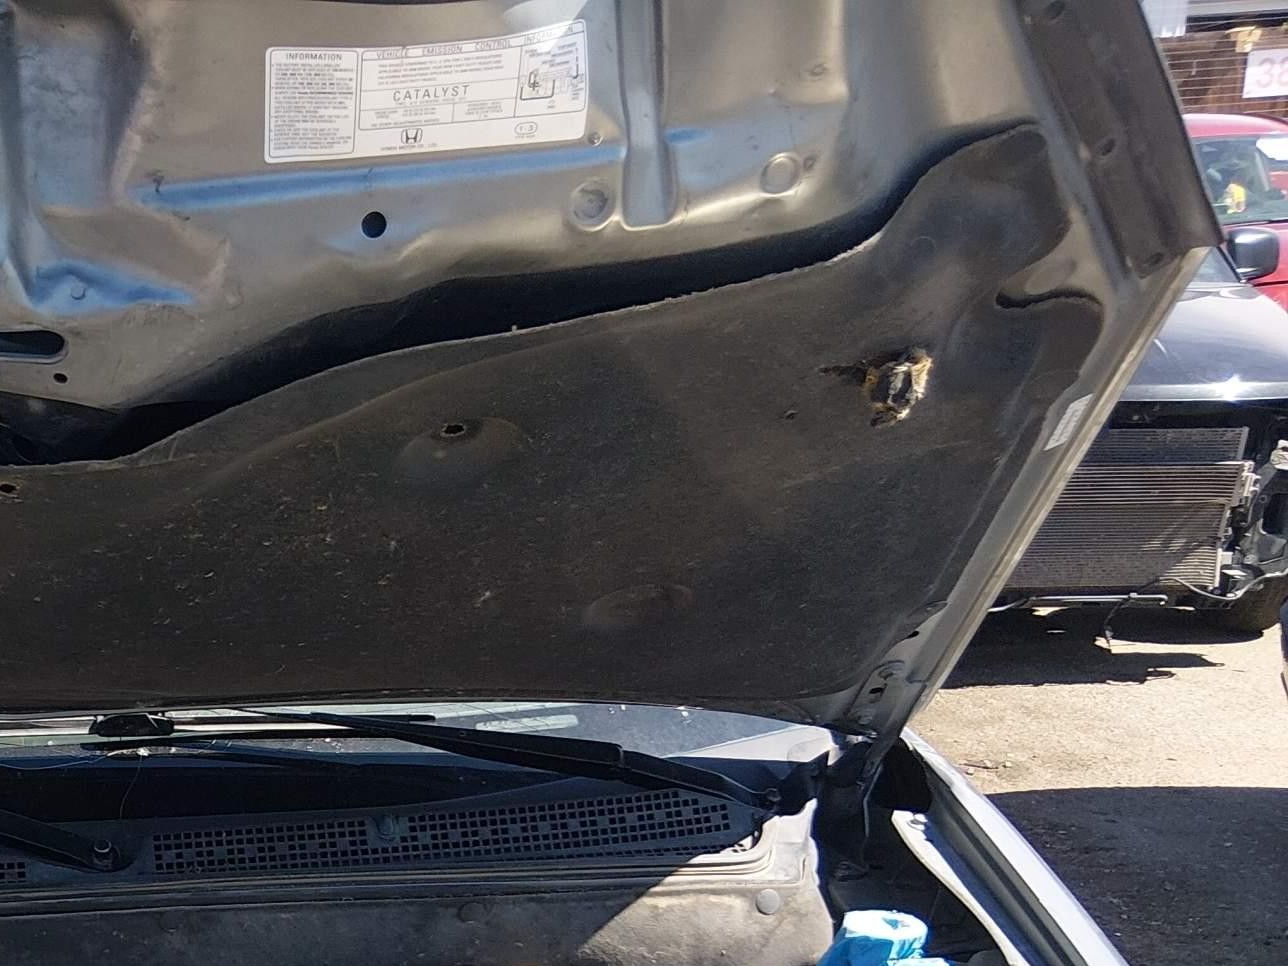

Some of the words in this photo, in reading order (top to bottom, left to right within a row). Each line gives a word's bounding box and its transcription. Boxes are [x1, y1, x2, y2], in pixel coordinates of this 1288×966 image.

[286, 53, 343, 61] INFORMATION
[376, 49, 407, 59] VEHICLE
[422, 44, 463, 56] EMISSION
[474, 39, 511, 50] CONTROL
[393, 84, 470, 102] CATALYST
